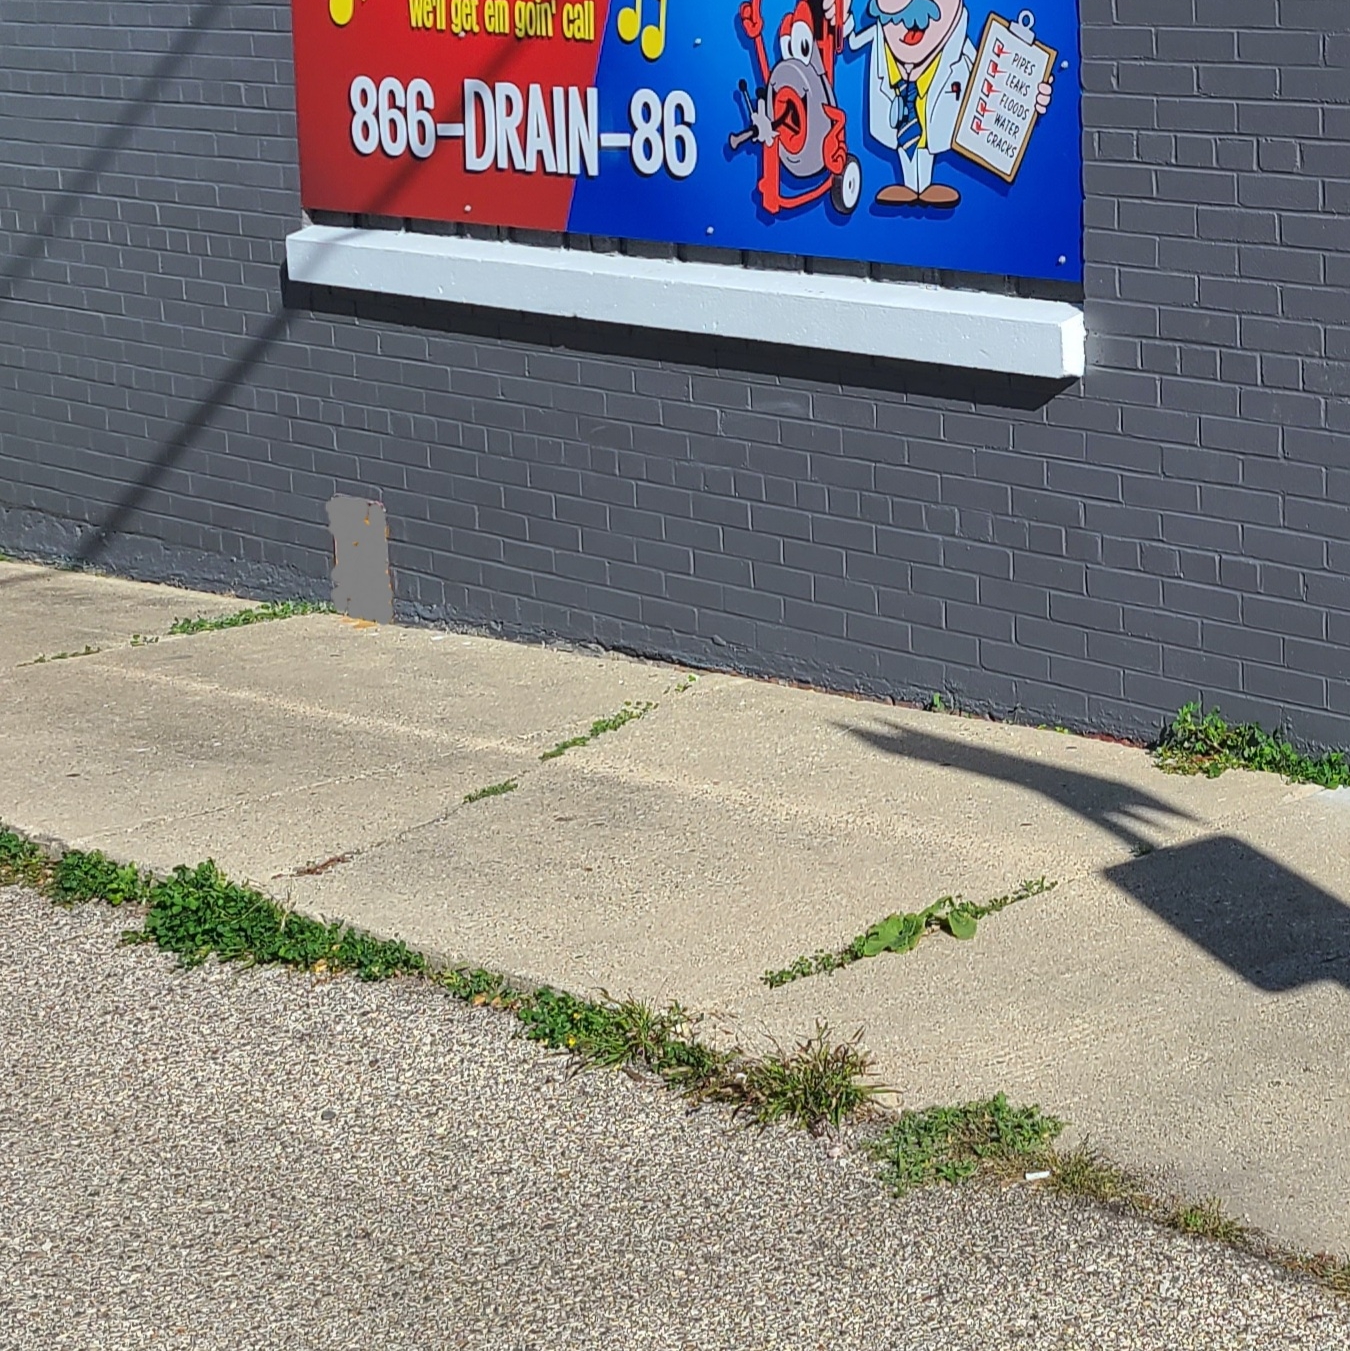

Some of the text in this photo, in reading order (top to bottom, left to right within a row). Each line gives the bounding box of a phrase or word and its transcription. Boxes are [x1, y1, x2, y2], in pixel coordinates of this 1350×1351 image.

[484, 0, 510, 34] em
[563, 0, 594, 41] call
[1013, 53, 1036, 77] PIPES
[1005, 72, 1031, 97] LEAKS
[1000, 93, 1030, 121] FLOODS
[350, 75, 698, 177] 866-DRAIN-86
[994, 112, 1020, 139] WATER
[986, 131, 1018, 159] CRACKS
